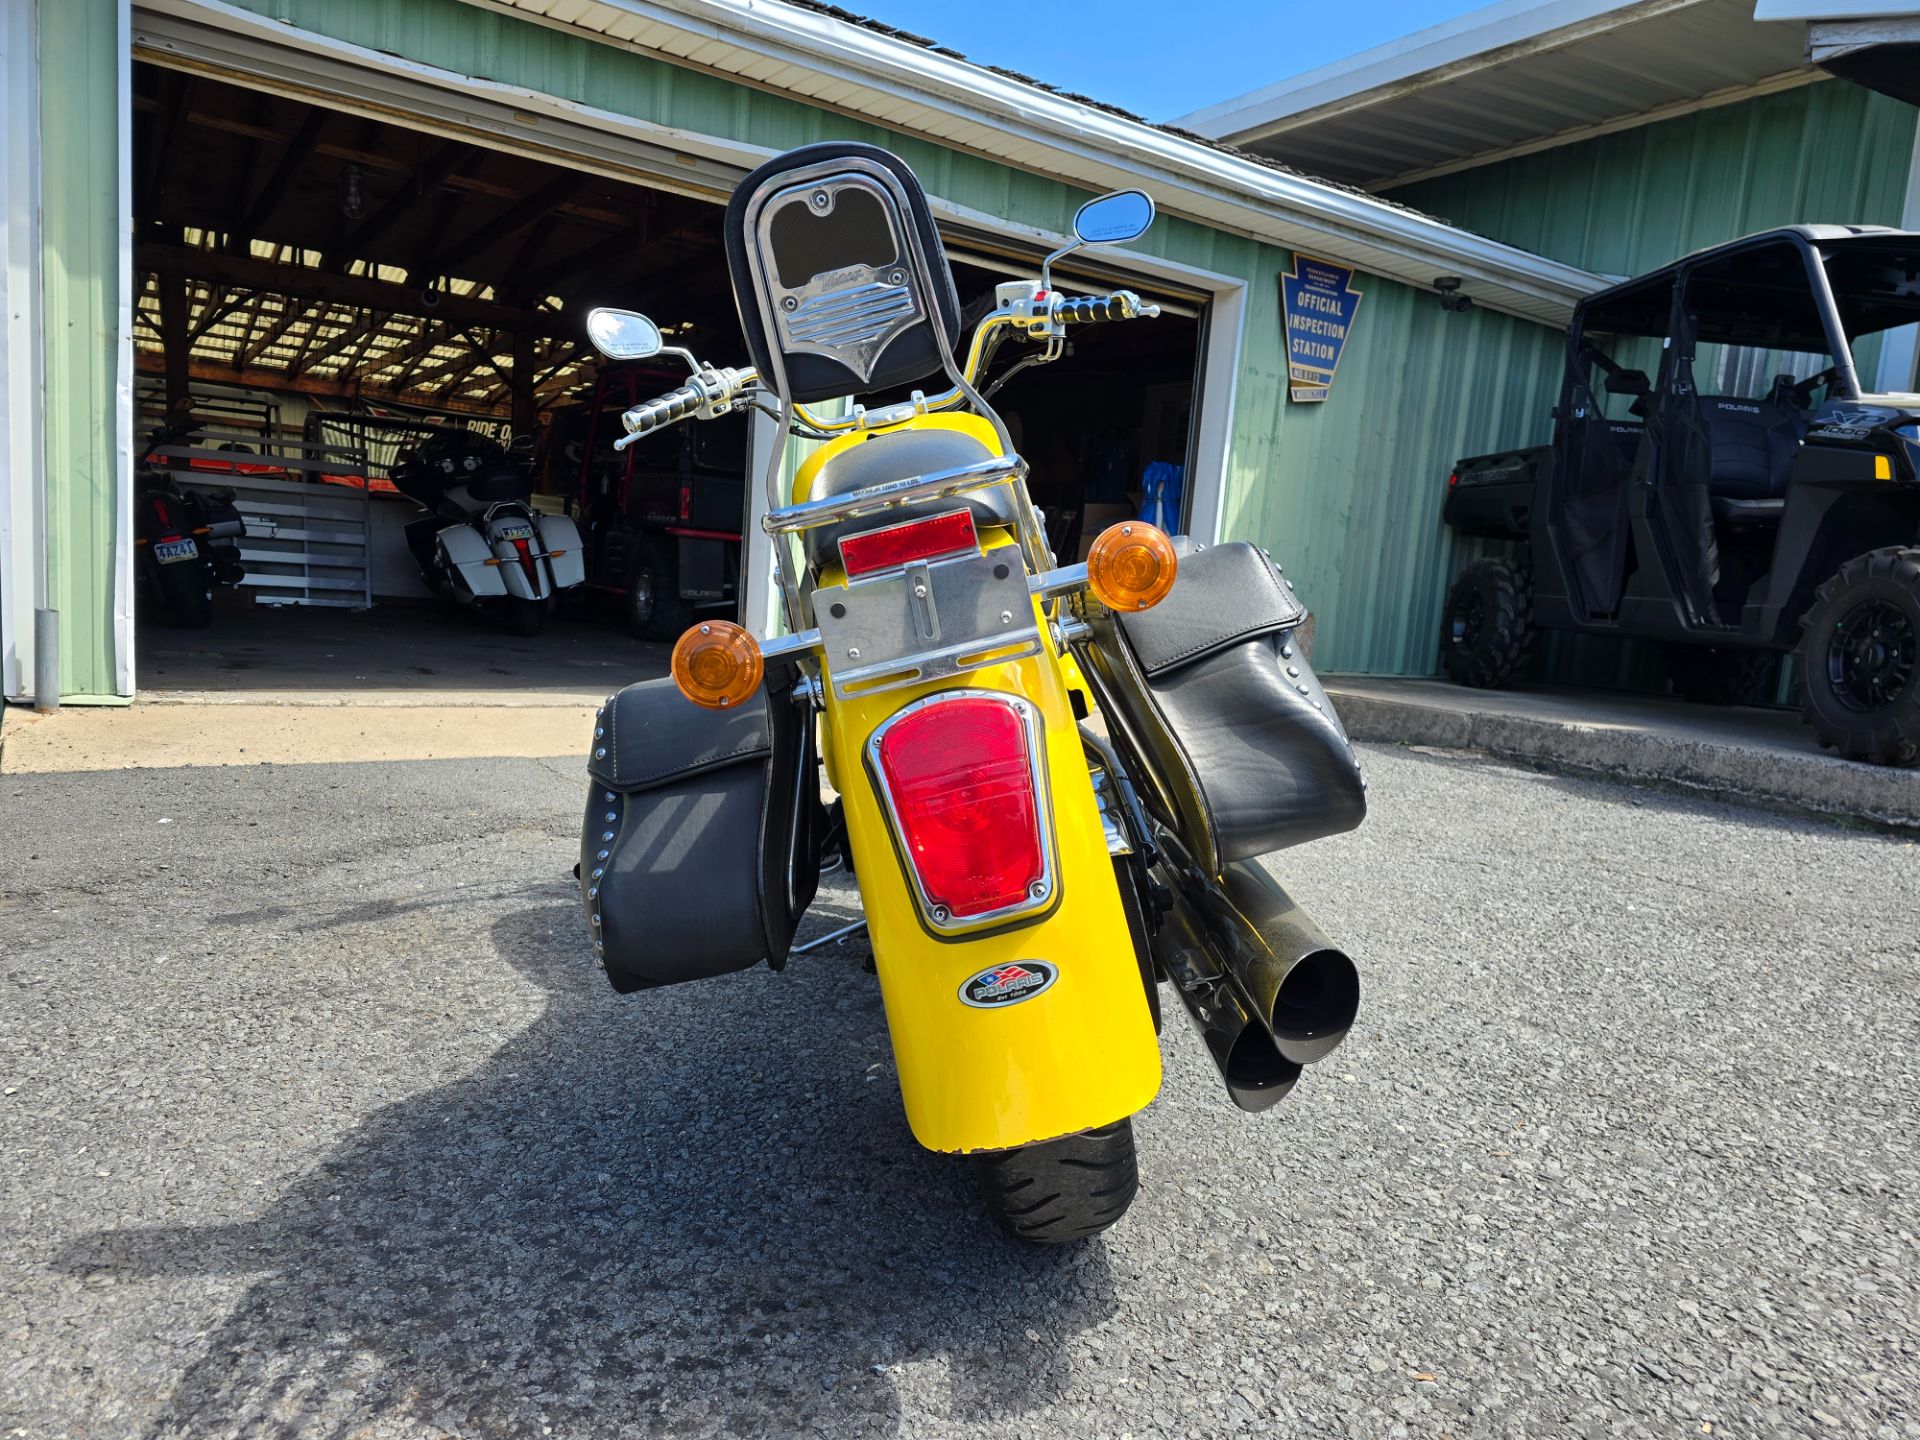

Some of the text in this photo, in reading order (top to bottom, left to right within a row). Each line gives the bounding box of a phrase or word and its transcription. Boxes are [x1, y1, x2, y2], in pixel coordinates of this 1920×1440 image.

[1297, 291, 1342, 316] OFFICIAL
[1289, 313, 1345, 339] INSPECTION
[1292, 338, 1334, 360] STATION
[1718, 402, 1760, 414] POLARIS
[466, 419, 498, 438] RIDE
[1815, 410, 1888, 427] XP
[1823, 425, 1871, 438] 1000
[973, 972, 1043, 1000] POLARIS
